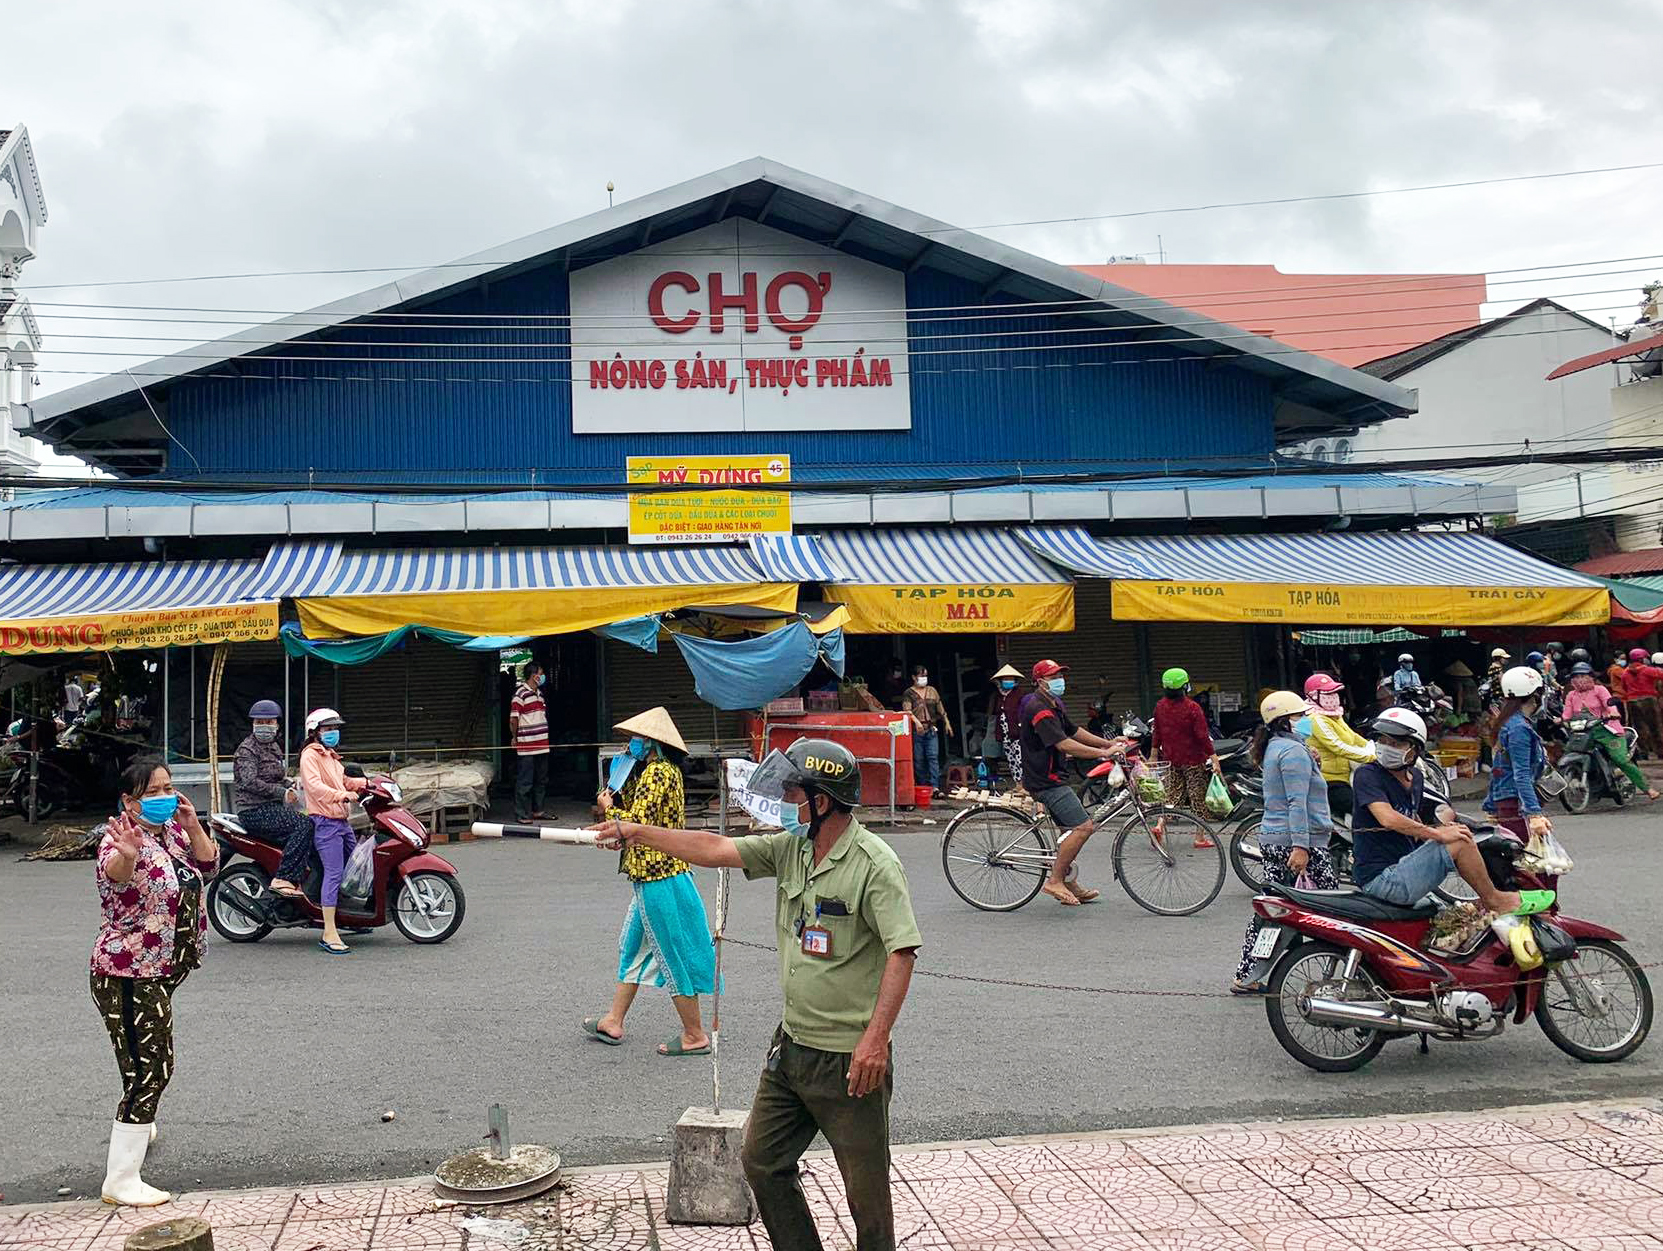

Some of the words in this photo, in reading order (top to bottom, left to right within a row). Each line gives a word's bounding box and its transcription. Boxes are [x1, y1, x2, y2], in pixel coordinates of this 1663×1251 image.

[648, 271, 832, 350] CHỢ
[590, 352, 667, 389] NÔNG
[674, 351, 737, 394] SẢN,
[745, 358, 809, 397] THỰC
[815, 346, 893, 387] PHẨM
[770, 464, 783, 473] 45
[675, 521, 690, 533] BIỆT
[697, 522, 713, 531] GIAO
[715, 520, 734, 531] HÀNG
[890, 588, 947, 601] TẠP
[958, 585, 1014, 598] HÓA
[1155, 585, 1186, 596] TẠP
[1192, 584, 1225, 596] HÓA
[1467, 589, 1508, 599] TRÁI
[1513, 588, 1546, 599] CÂY
[1288, 590, 1312, 608] TẠP
[1316, 587, 1341, 606] HÓA
[215, 608, 232, 617] Các
[946, 603, 990, 619] MAI
[110, 625, 134, 637] CHUỐI
[804, 755, 845, 776] BVDP
